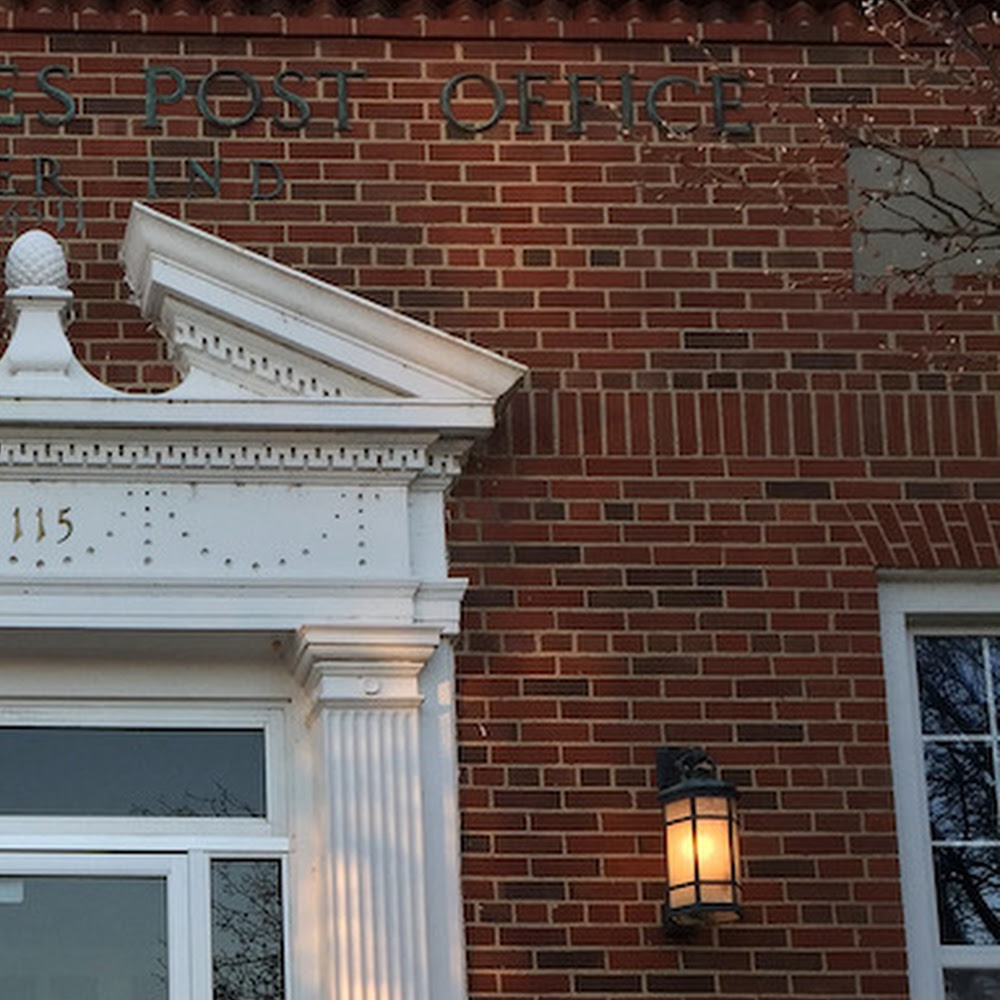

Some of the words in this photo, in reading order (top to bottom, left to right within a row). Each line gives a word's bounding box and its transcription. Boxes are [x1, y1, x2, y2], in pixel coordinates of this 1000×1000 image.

[142, 66, 370, 133] POST
[439, 71, 754, 138] OFFICE
[147, 155, 285, 202] IND
[13, 506, 74, 545] 115
